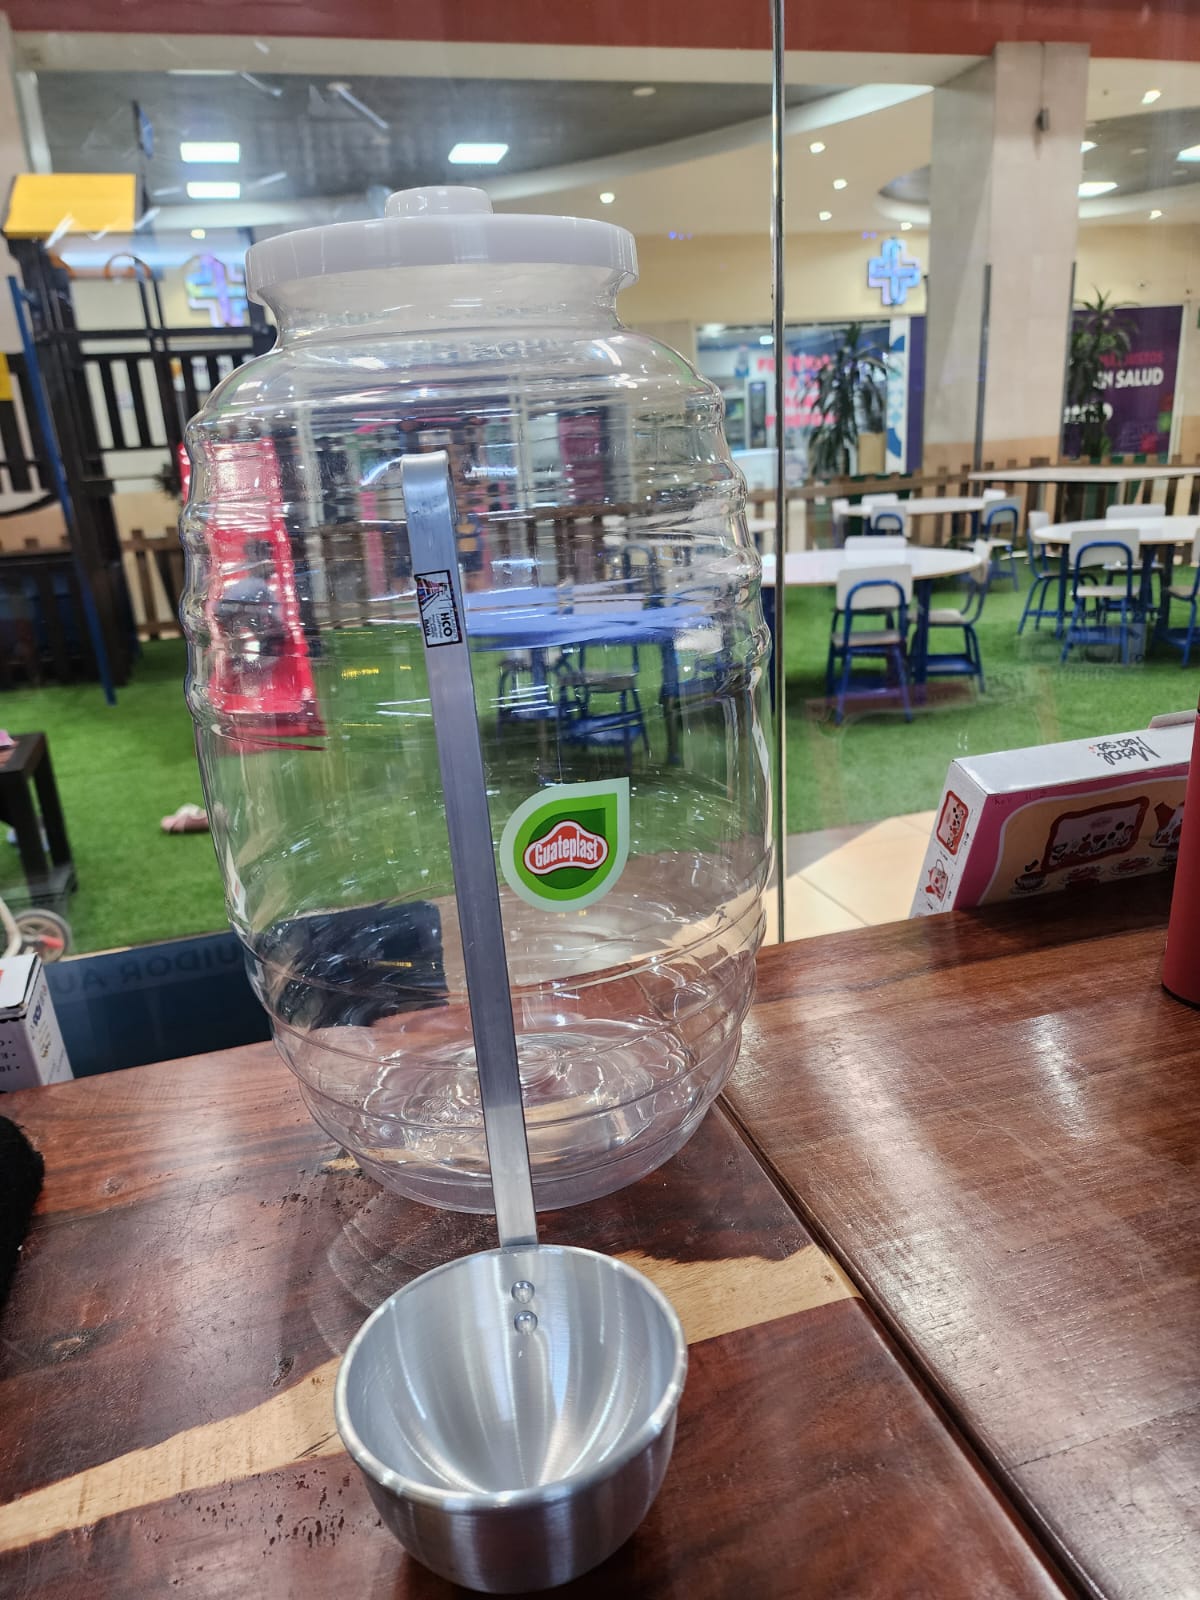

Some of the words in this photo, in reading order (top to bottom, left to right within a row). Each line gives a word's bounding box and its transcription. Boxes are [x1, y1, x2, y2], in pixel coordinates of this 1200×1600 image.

[1115, 367, 1164, 388] SALUD
[440, 612, 453, 637] HCO
[1097, 736, 1161, 766] Metal
[534, 829, 599, 867] Guateplast
